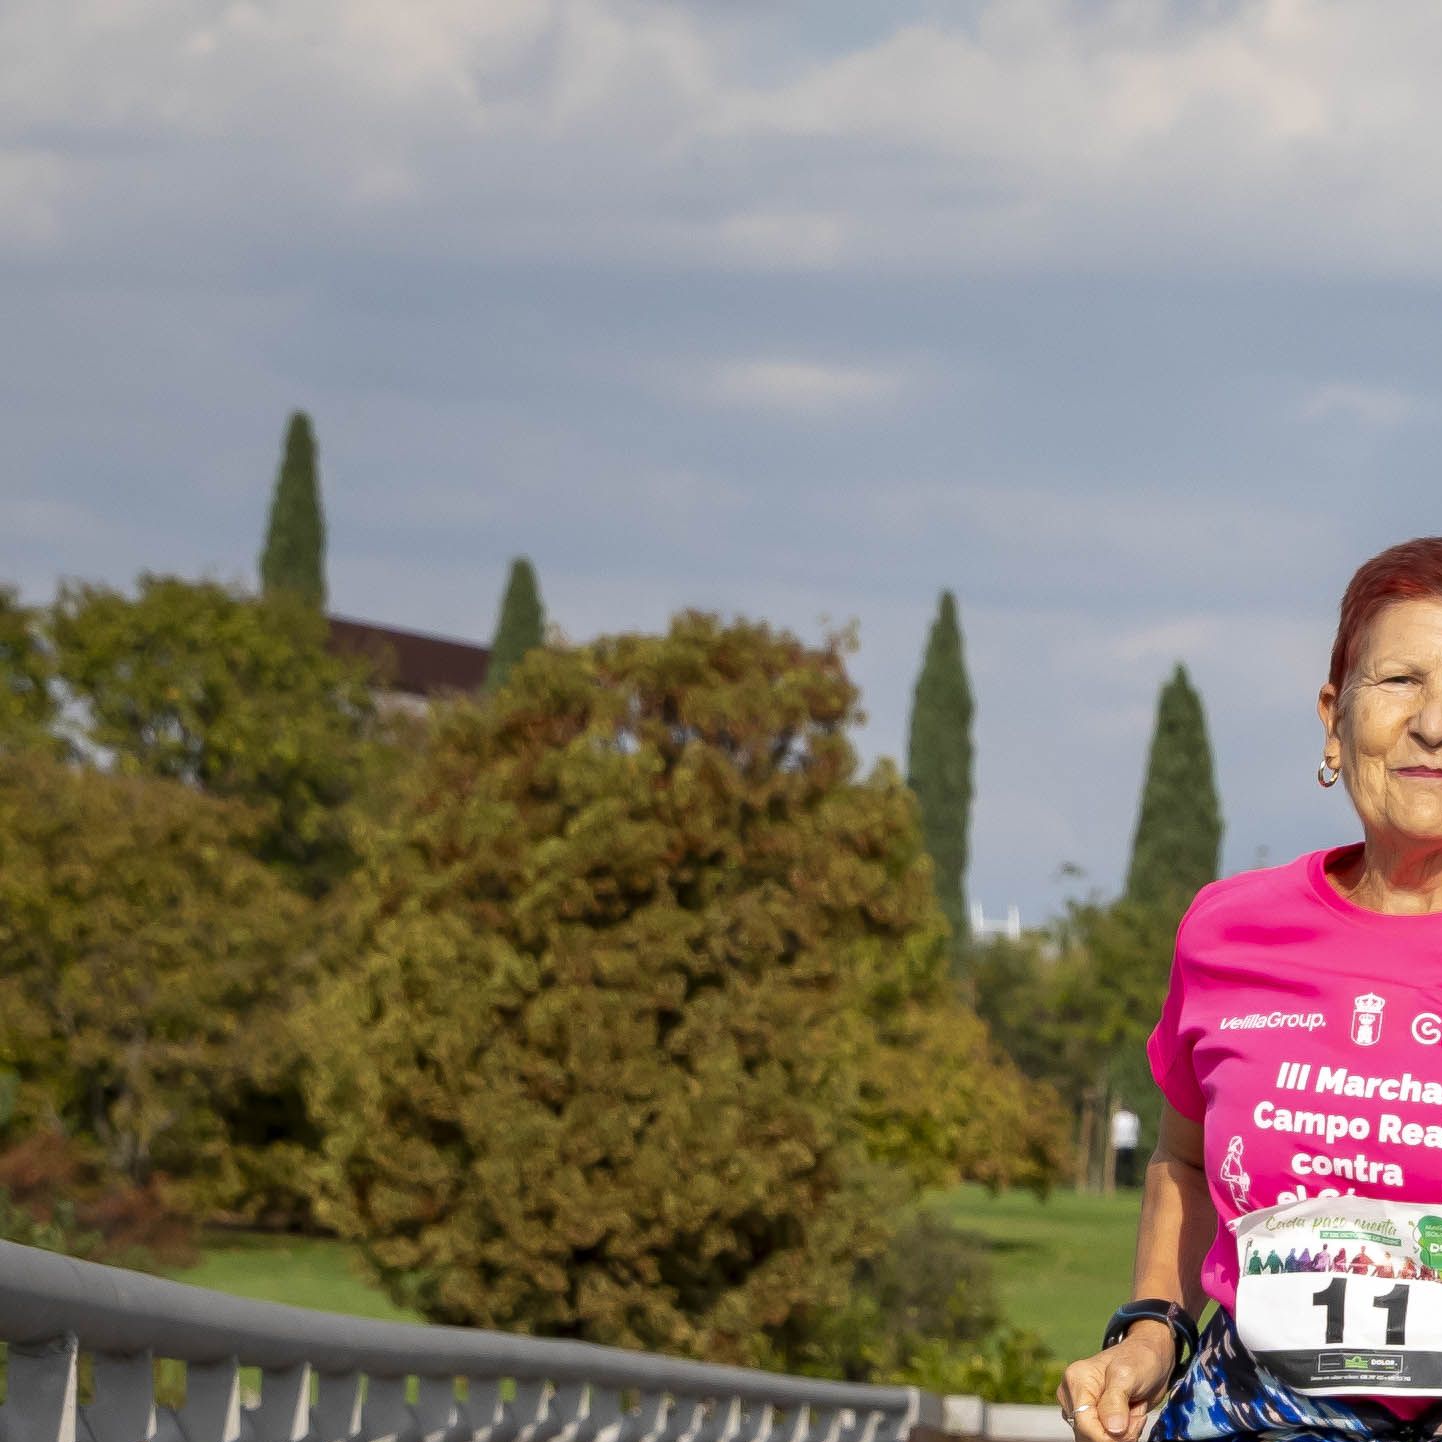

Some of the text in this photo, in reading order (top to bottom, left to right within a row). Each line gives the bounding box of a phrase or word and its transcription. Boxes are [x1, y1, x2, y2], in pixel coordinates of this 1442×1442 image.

[1276, 1061, 1311, 1091] III
[1253, 1100, 1370, 1144] Campo
[1291, 1152, 1404, 1187] contra
[1313, 1277, 1410, 1346] 11
